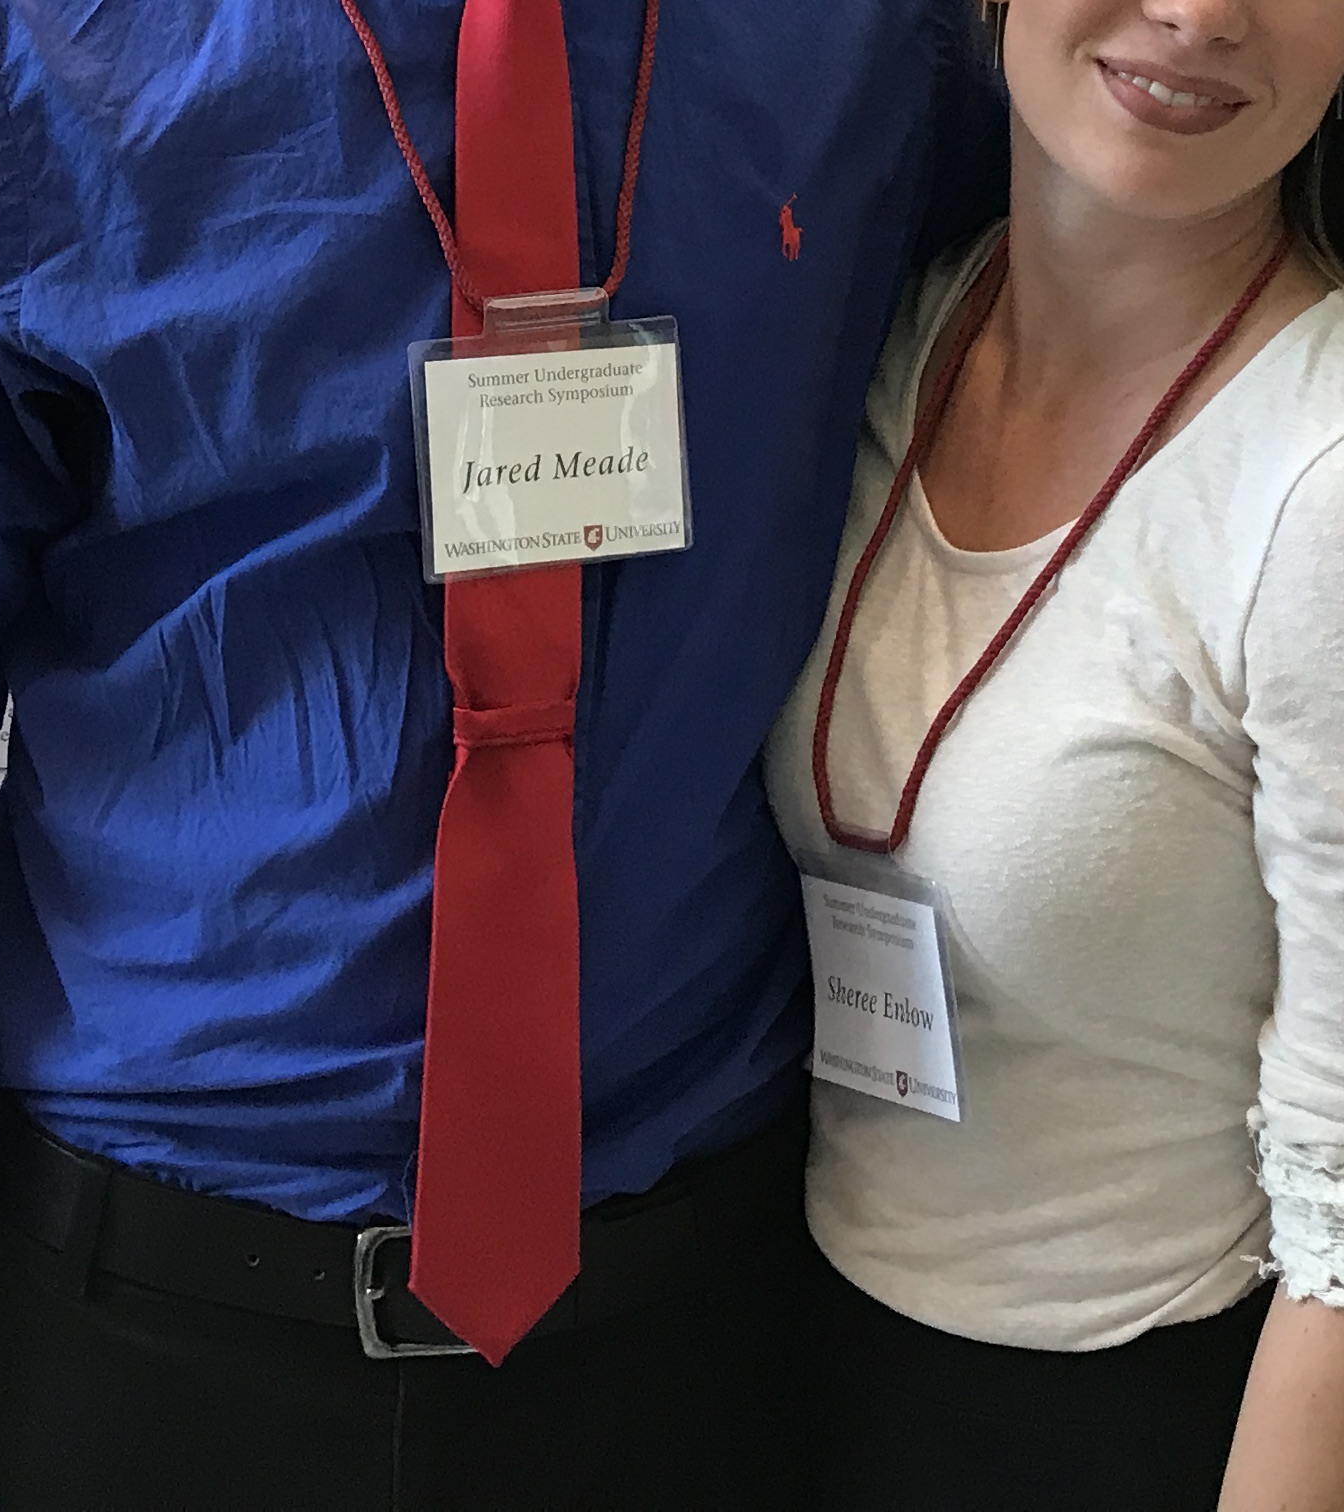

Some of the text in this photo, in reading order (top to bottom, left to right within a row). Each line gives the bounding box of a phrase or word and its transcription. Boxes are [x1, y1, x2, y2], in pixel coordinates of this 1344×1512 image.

[467, 361, 643, 389] Summer Undergraduate
[479, 383, 634, 409] Research Symposium
[462, 445, 649, 495] Jared Meade
[444, 519, 681, 559] WASHINGTON STATE UNIVERSITY
[827, 974, 935, 1033] Sheree Enlow
